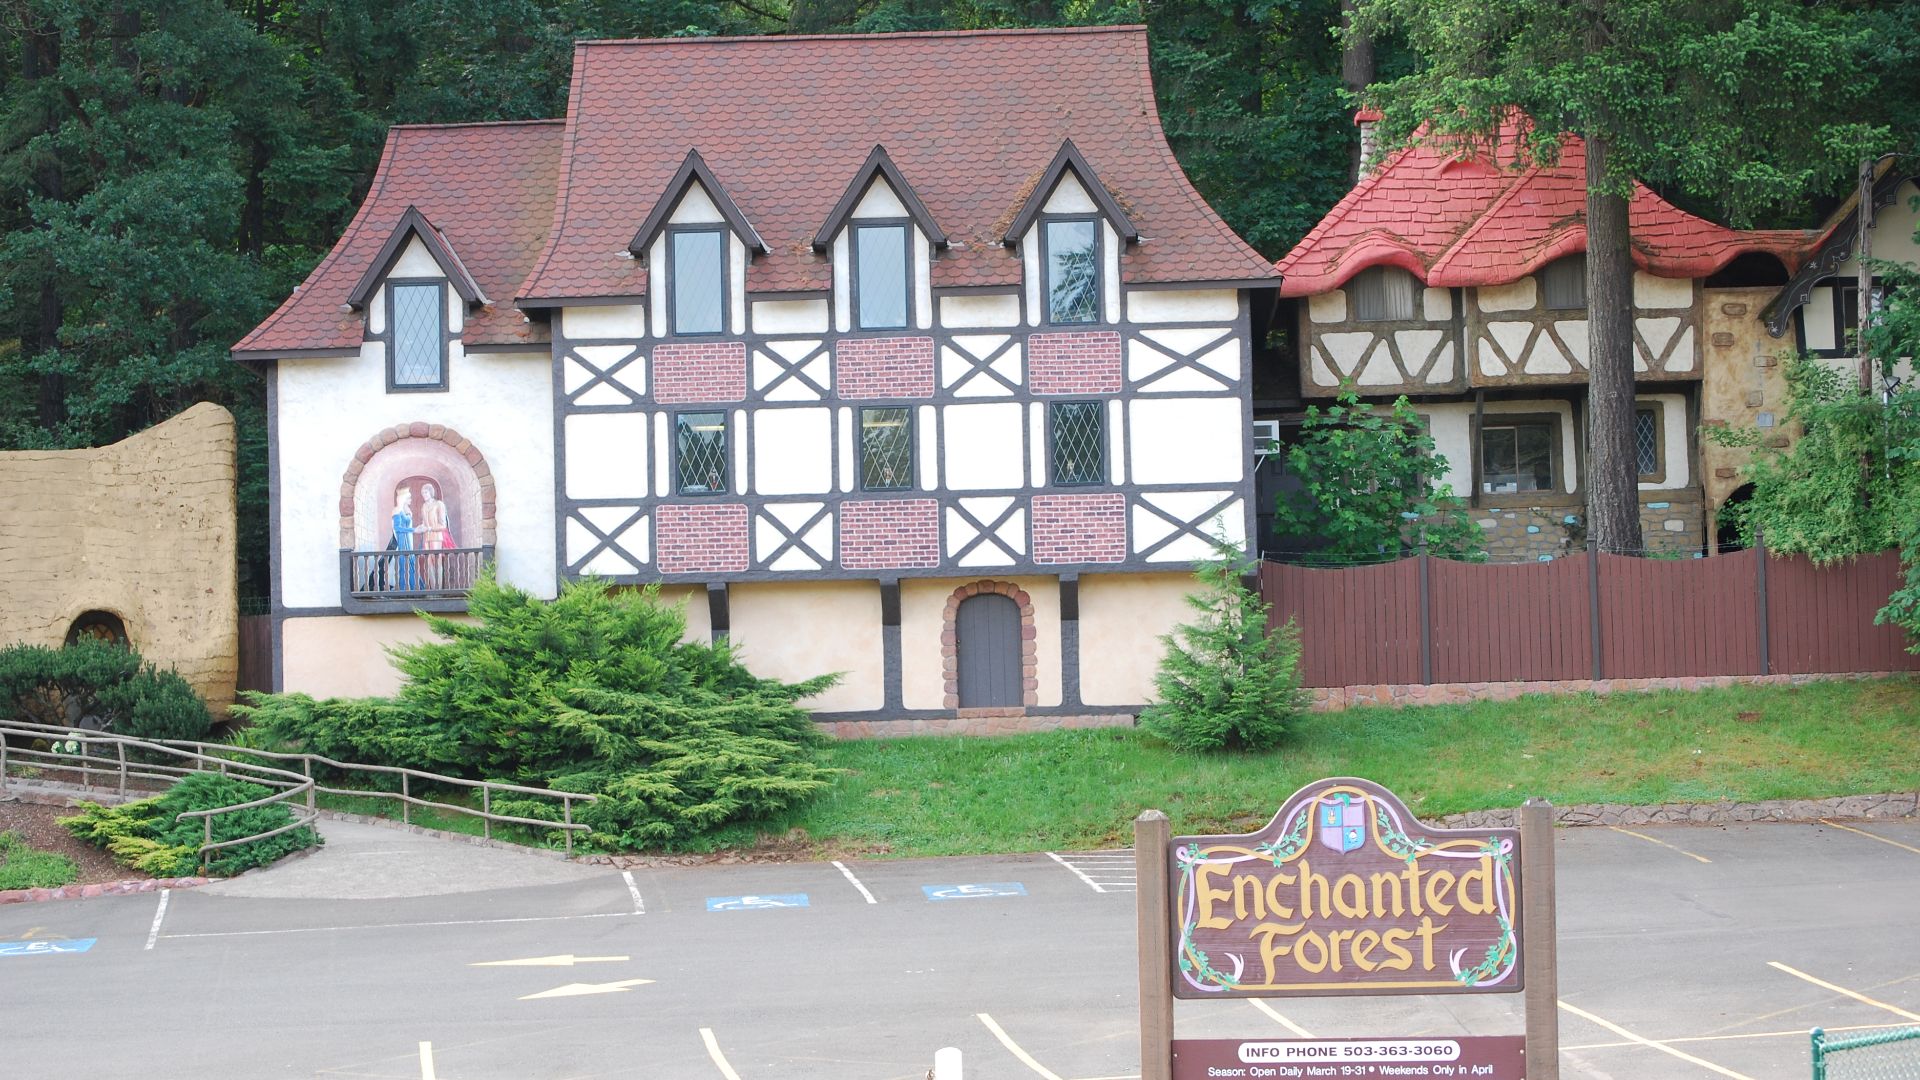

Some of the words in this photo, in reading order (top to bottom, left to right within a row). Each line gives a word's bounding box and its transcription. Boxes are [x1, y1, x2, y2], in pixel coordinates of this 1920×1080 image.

[1195, 855, 1498, 930] Enchanted
[1249, 916, 1449, 984] Forest
[1208, 1066, 1246, 1077] Season:
[1250, 1066, 1276, 1078] Open
[1280, 1066, 1304, 1078] Daily
[1307, 1066, 1337, 1076] March
[1341, 1065, 1366, 1076] 19-31
[1379, 1065, 1429, 1075] Weekends
[1433, 1065, 1455, 1076] Only
[1459, 1064, 1467, 1075] in
[1471, 1064, 1493, 1076] April
[1246, 1047, 1280, 1058] INFO
[1286, 1047, 1338, 1058] PHONE
[1344, 1045, 1453, 1056] 503-363-3060
